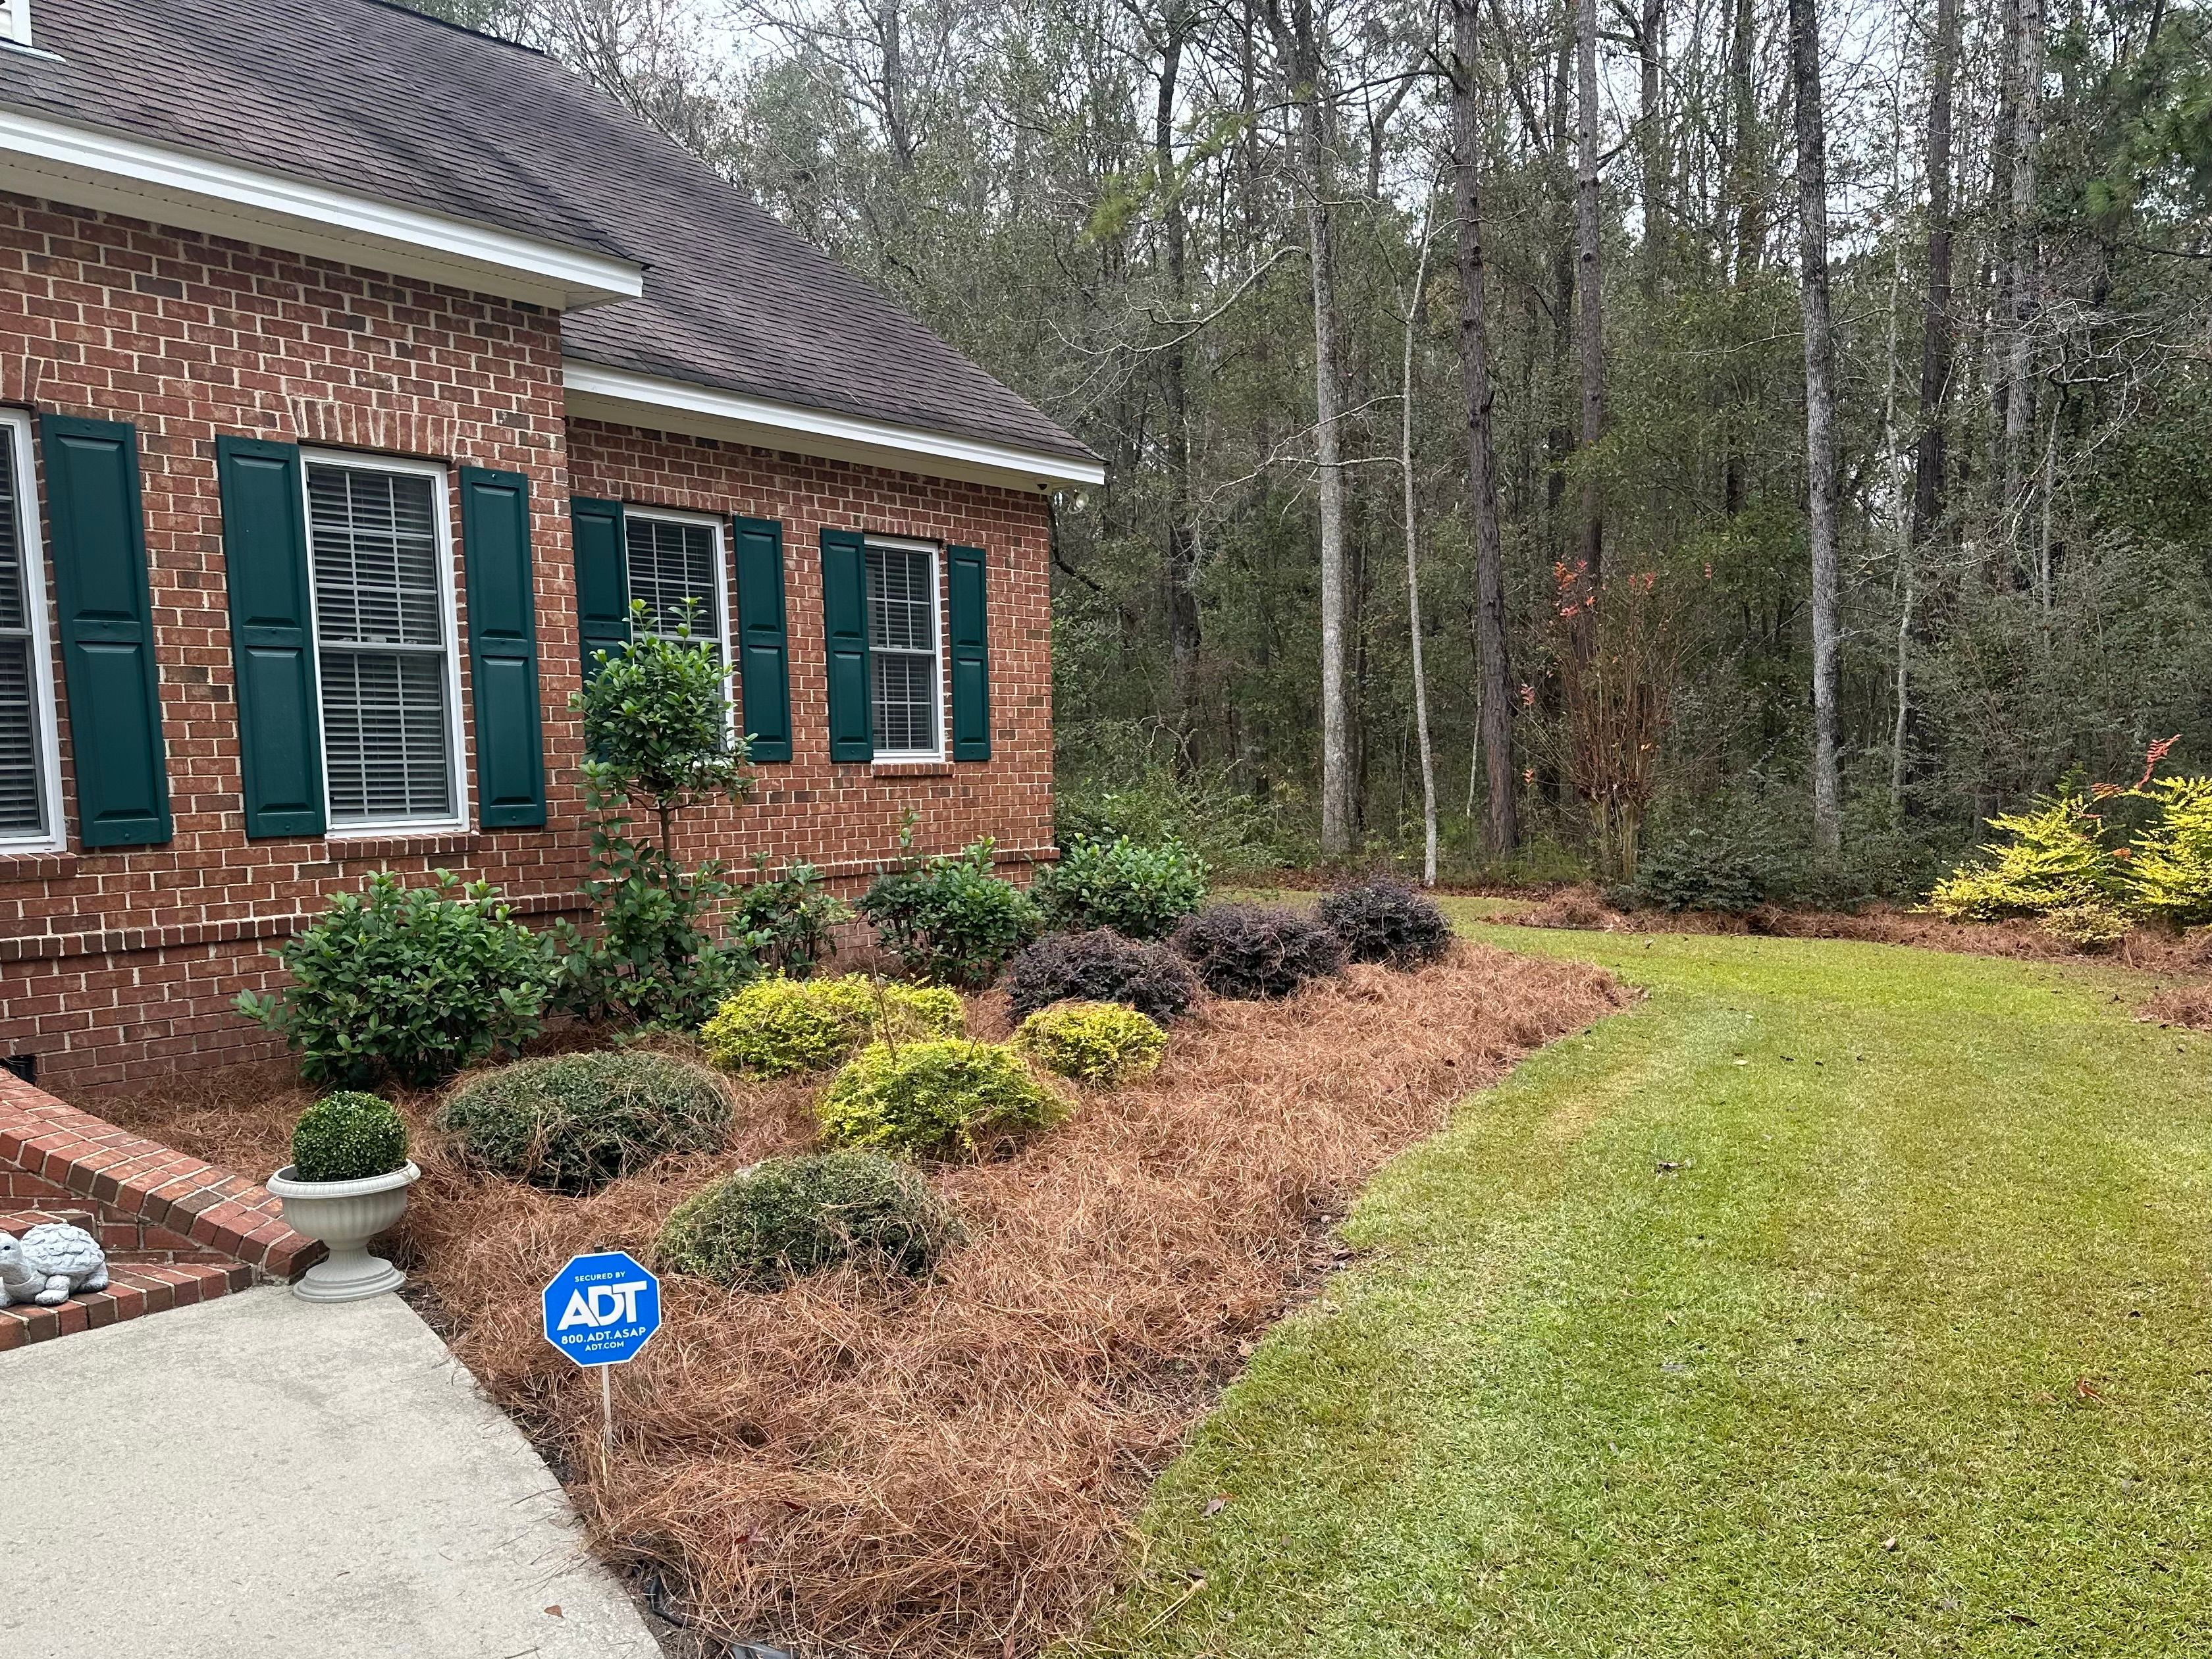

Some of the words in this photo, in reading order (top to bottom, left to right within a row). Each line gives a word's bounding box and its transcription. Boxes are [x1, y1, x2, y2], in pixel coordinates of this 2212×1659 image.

[574, 1273, 613, 1282] SECURED
[556, 1280, 647, 1330] ADT
[561, 1327, 646, 1344] 800.ADT.ASAP
[585, 1341, 624, 1352] ADT.COM
